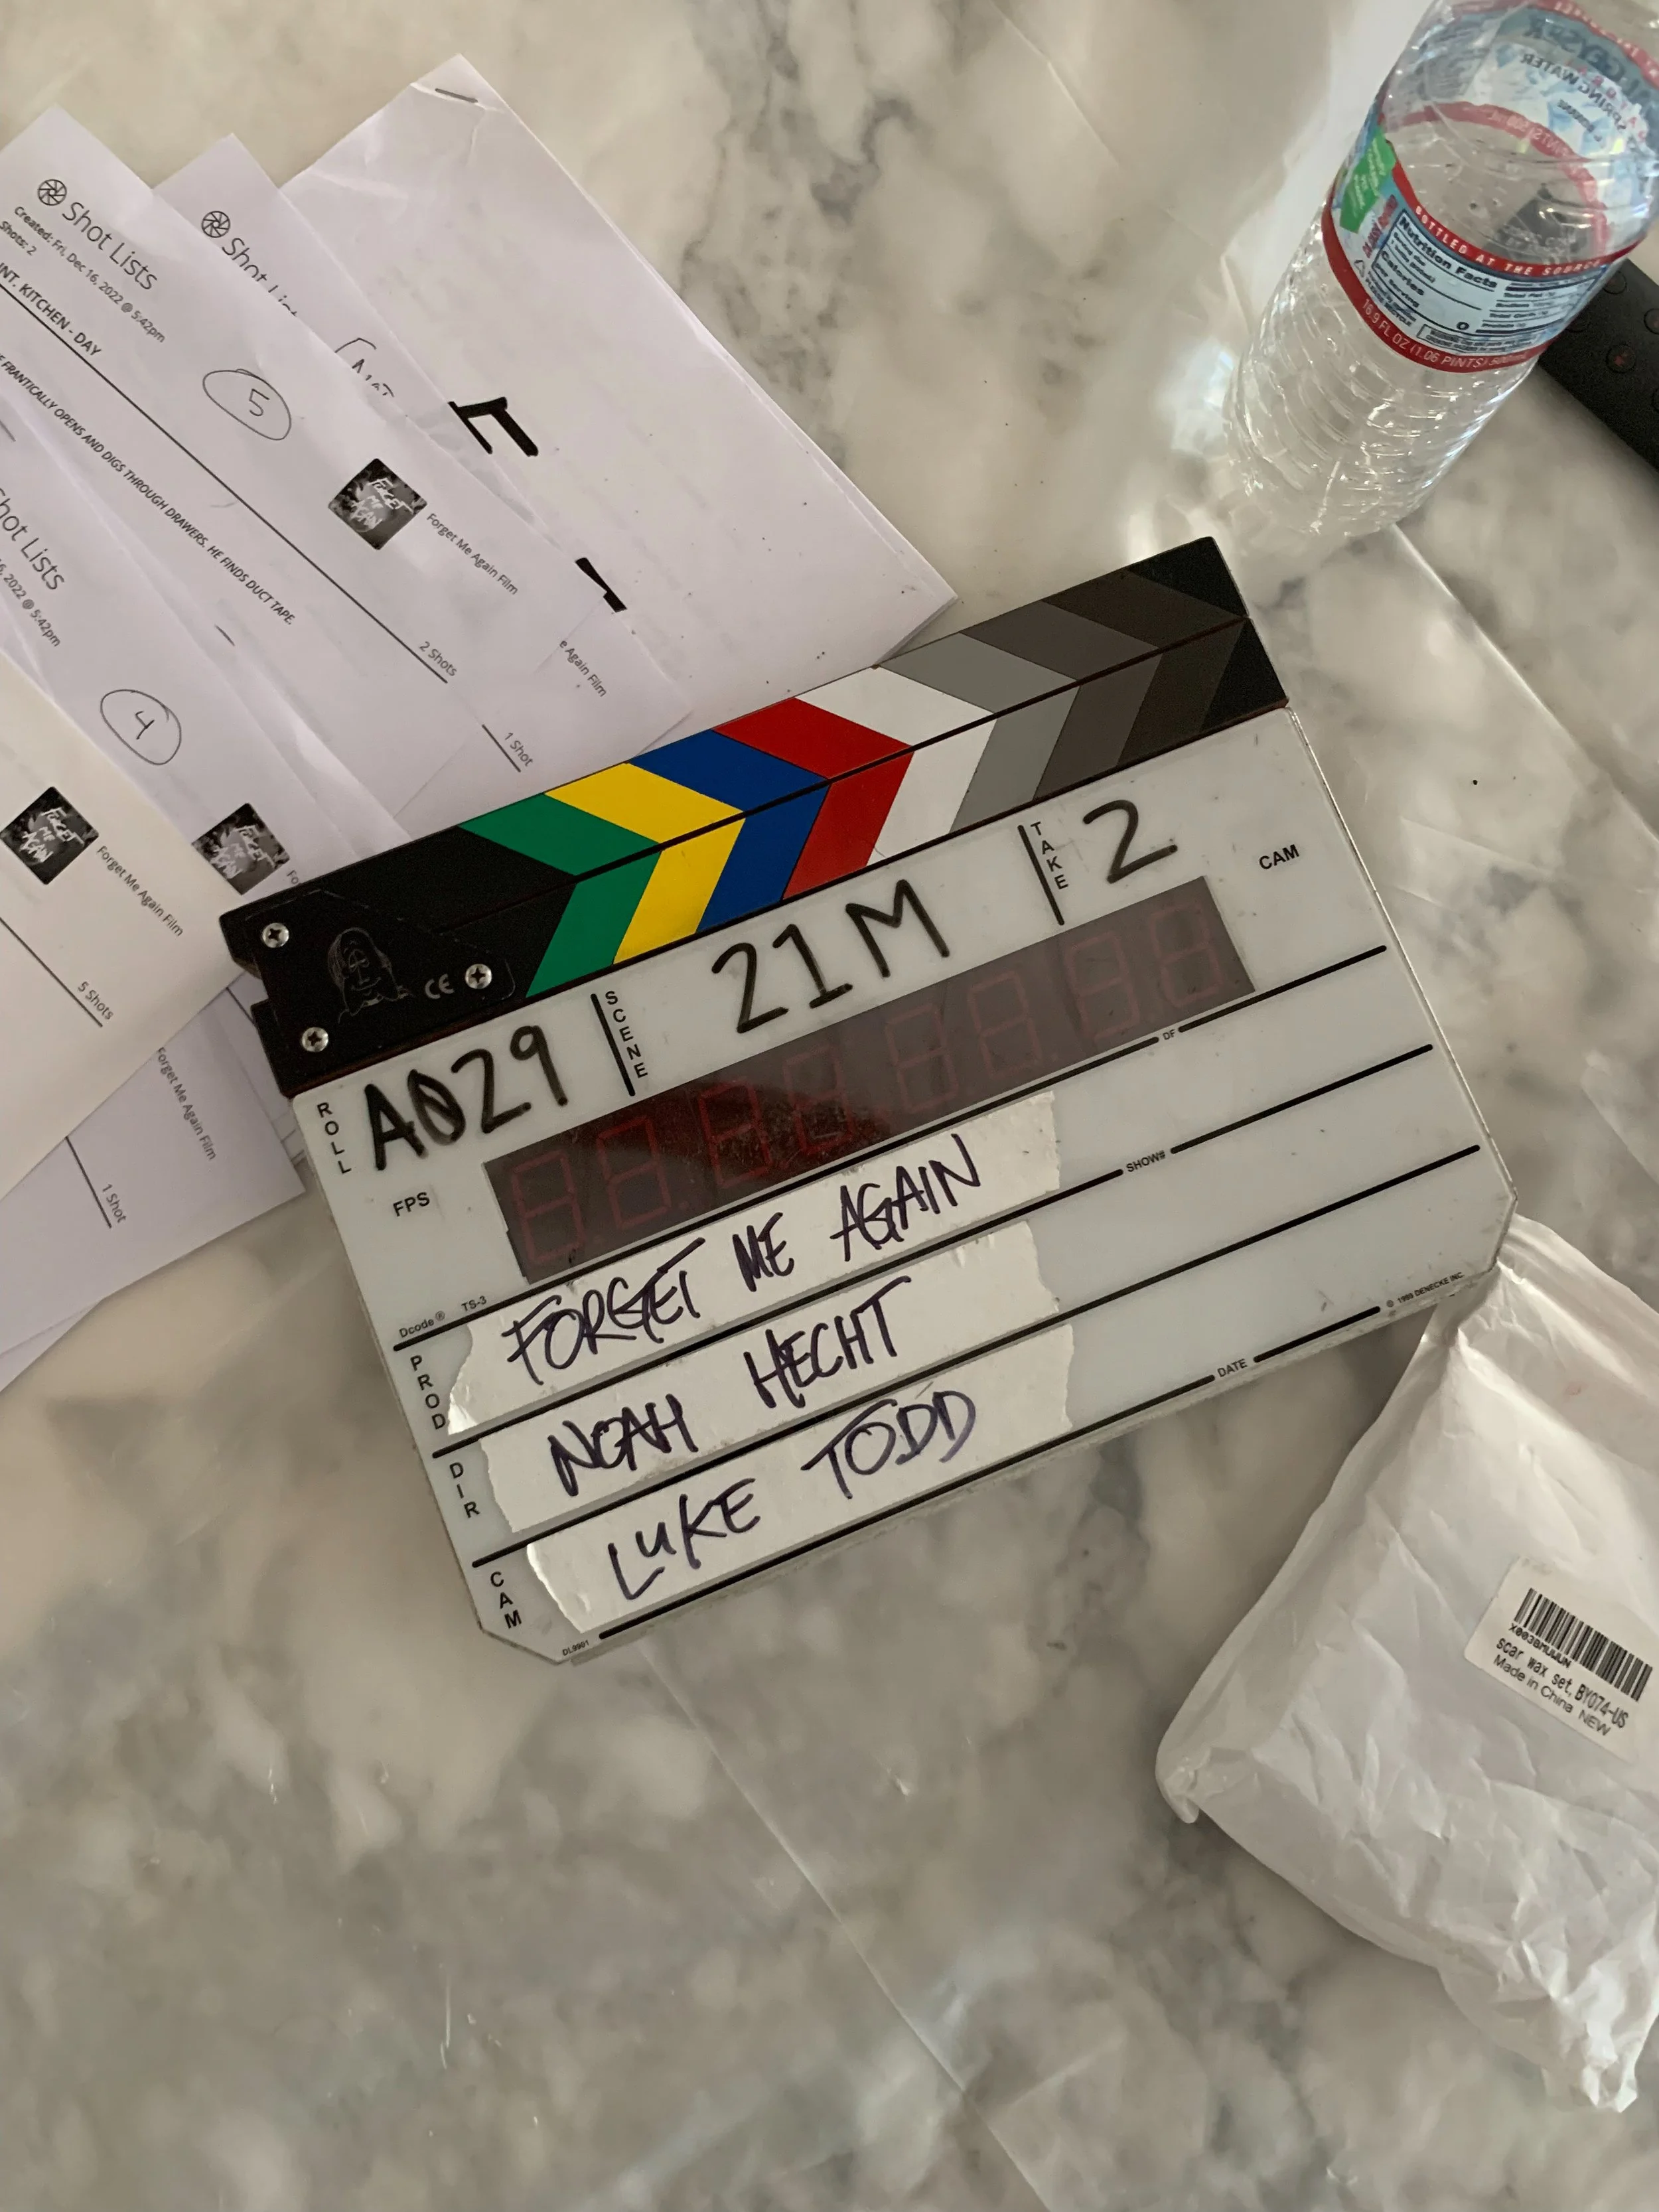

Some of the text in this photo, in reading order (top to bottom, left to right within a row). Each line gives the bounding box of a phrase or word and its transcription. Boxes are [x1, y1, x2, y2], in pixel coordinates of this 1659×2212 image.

[0, 220, 37, 256] Shots: 2
[62, 201, 158, 291] Shot Lists
[1399, 216, 1452, 269] Nutrition
[1455, 266, 1498, 288] Facts
[1415, 206, 1468, 254] BOTTLED
[1475, 254, 1495, 265] AT
[1504, 263, 1533, 275] THE
[0, 262, 21, 287] INT.
[19, 283, 70, 330] KITCHEN
[74, 332, 102, 356] DAY
[15, 206, 54, 243] Created:
[52, 240, 68, 258] Fri,
[66, 252, 86, 272] Dec
[86, 269, 100, 285] 16,
[99, 281, 123, 305] 2022
[131, 310, 165, 343] 5:42pm
[1378, 321, 1390, 337] FL
[1393, 333, 1410, 350] OZ
[248, 388, 270, 417] 5
[2, 361, 296, 625] FRANTICALLY OPENS AND DIGS THROUGH DRAWERS. HE FINDS DUCT TAPE.
[0, 488, 65, 591] hot Lists
[427, 513, 519, 595] Forget Me Again Film
[3, 573, 27, 599] 2022
[30, 609, 61, 647] 5:42pm
[419, 641, 458, 677] 2 Shots
[565, 646, 590, 677] Again
[587, 673, 607, 698] Film
[135, 711, 155, 740] 4
[504, 731, 534, 767] 1 Shot
[1031, 822, 1068, 890] TAKE
[1083, 799, 1178, 884] 2
[1259, 844, 1301, 870] CAM
[96, 845, 184, 936] Forget Me Again Film
[711, 879, 950, 1034] 21M
[78, 981, 114, 1020] 5 Shots
[605, 991, 648, 1078] SCENE
[157, 1047, 216, 1161] Forget Me Again Film
[317, 1102, 351, 1174] ROLL
[1125, 1149, 1166, 1173] SHOW#
[108, 1193, 127, 1223] Shot
[393, 1192, 430, 1217] FPS
[502, 1133, 981, 1385] FORGET ME AGAIN
[1414, 1277, 1449, 1297] DENECKE
[461, 1295, 486, 1312] TS-3
[410, 1355, 447, 1430] PROD
[547, 1275, 912, 1497] NOAH HECHT
[1217, 1358, 1248, 1378] DATE
[449, 1462, 480, 1517] DIR
[609, 1390, 976, 1601] LUKE TODD
[490, 1572, 522, 1629] CAM
[1496, 1637, 1524, 1660] scar
[1527, 1657, 1548, 1678] wax
[1494, 1655, 1611, 1736] Made in China NEW
